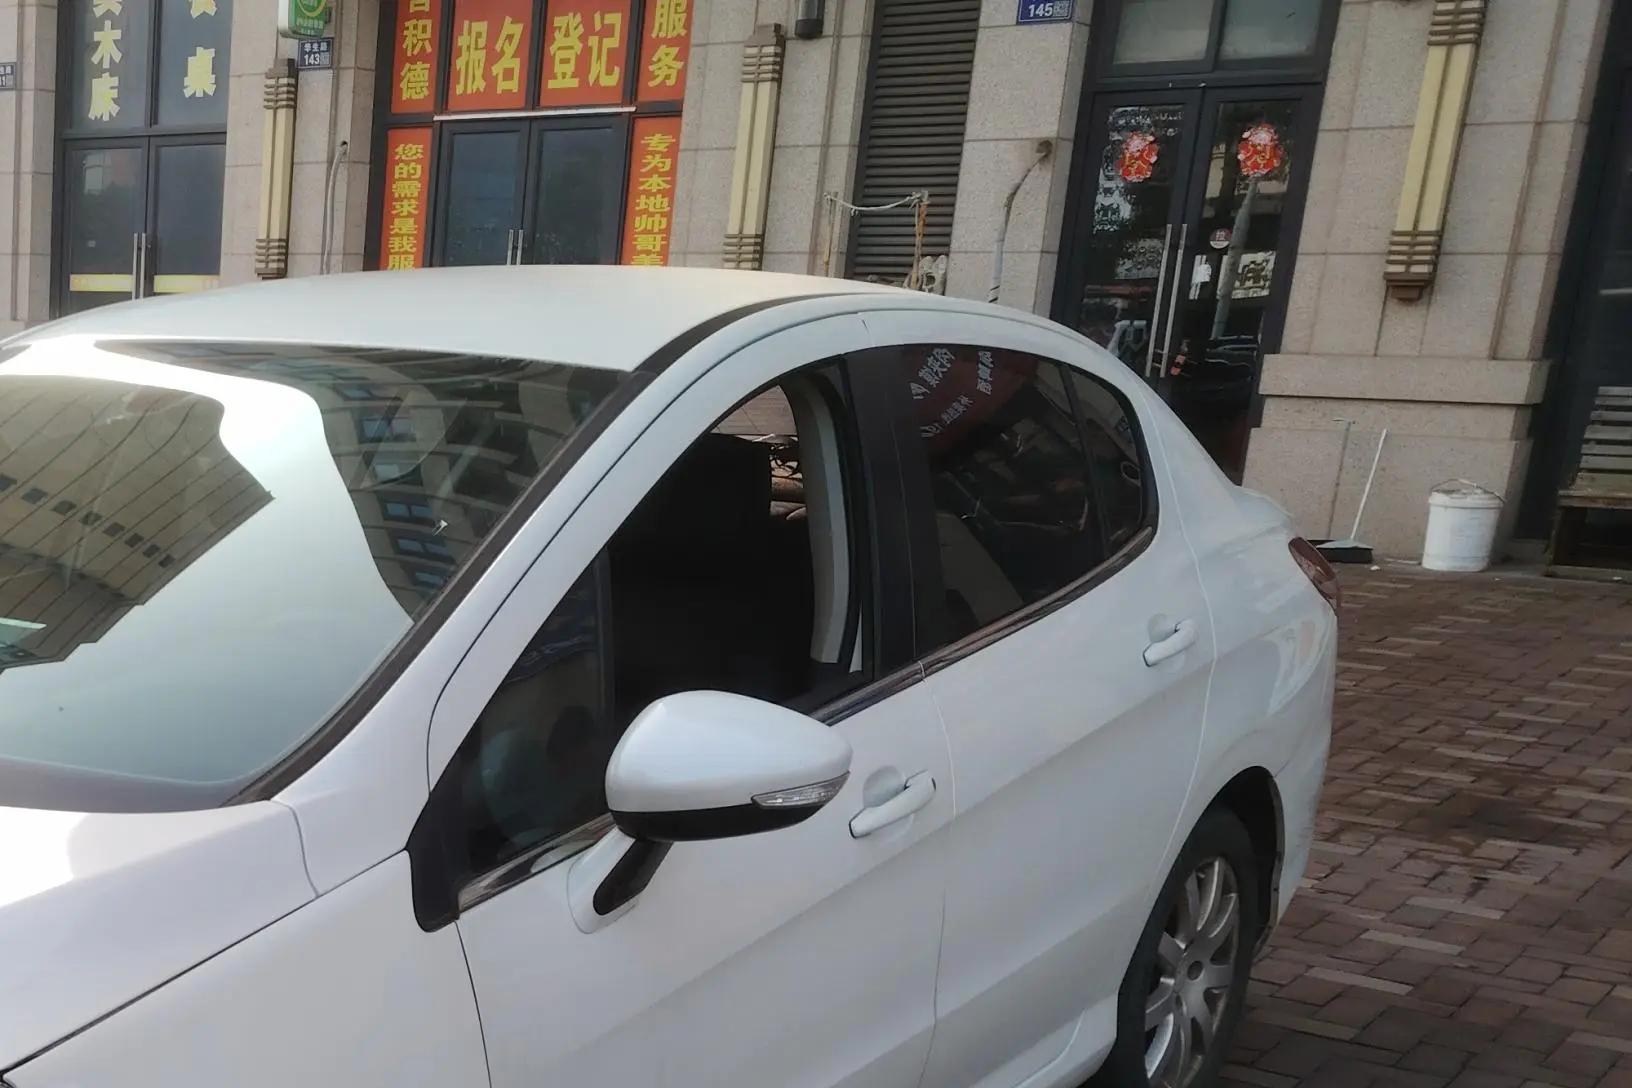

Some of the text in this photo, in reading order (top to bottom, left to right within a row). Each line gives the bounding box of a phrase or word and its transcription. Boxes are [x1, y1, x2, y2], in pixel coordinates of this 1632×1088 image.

[400, 0, 433, 100] 积德
[648, 0, 687, 87] 服务
[1029, 3, 1053, 17] 145
[304, 54, 320, 65] 143
[456, 11, 622, 95] 报名登记
[388, 143, 424, 270] 您的需求是我服
